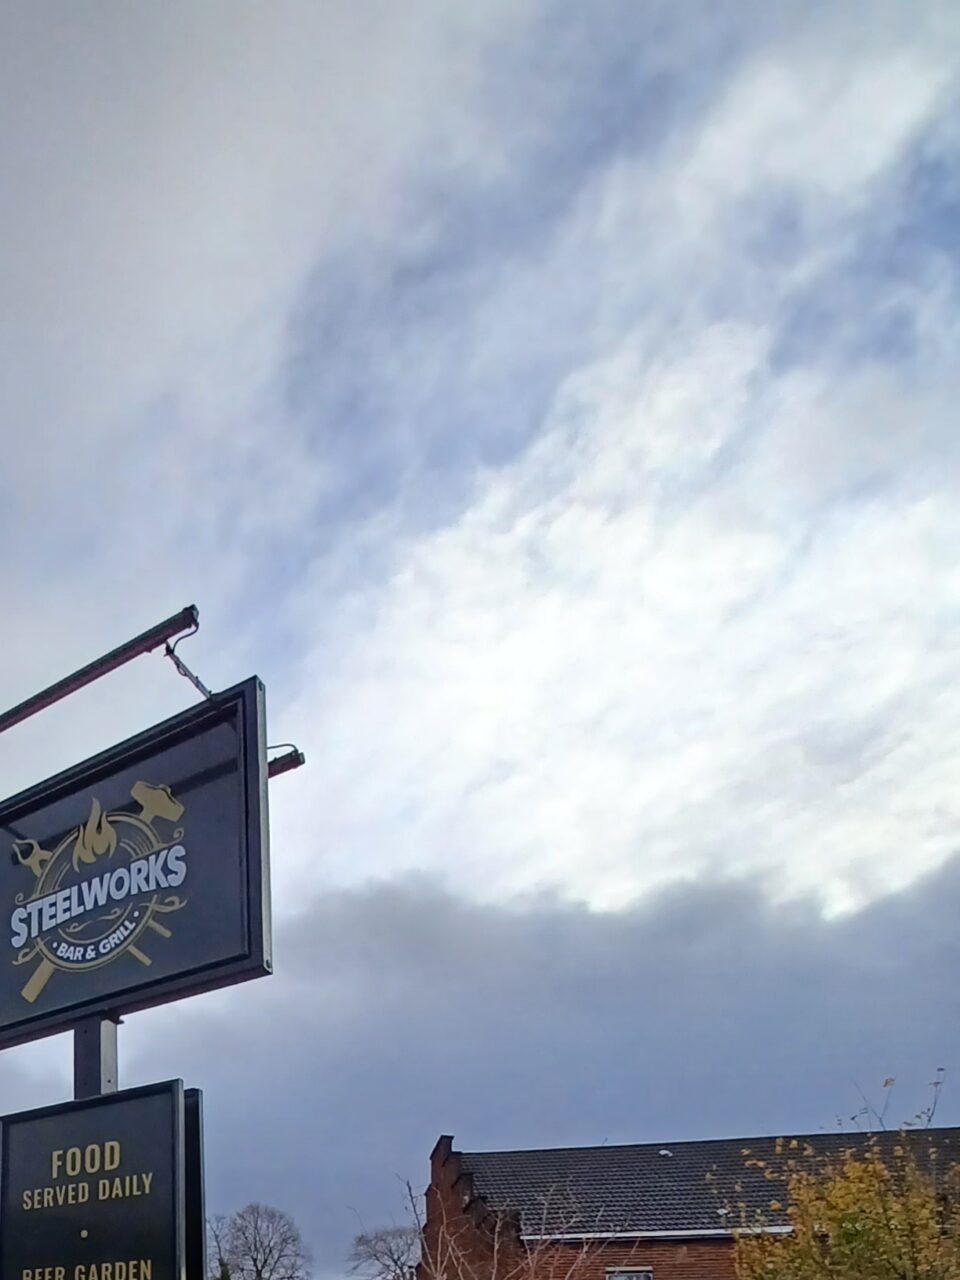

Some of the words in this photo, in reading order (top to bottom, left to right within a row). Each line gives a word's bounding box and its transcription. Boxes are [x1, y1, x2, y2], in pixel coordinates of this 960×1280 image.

[11, 845, 187, 948] STEELWORKS
[56, 943, 83, 961] BAR
[85, 947, 96, 959] &
[98, 920, 136, 953] GRILL
[51, 1141, 120, 1178] FOOD
[22, 1183, 89, 1210] SERVED
[98, 1172, 153, 1200] DAILY
